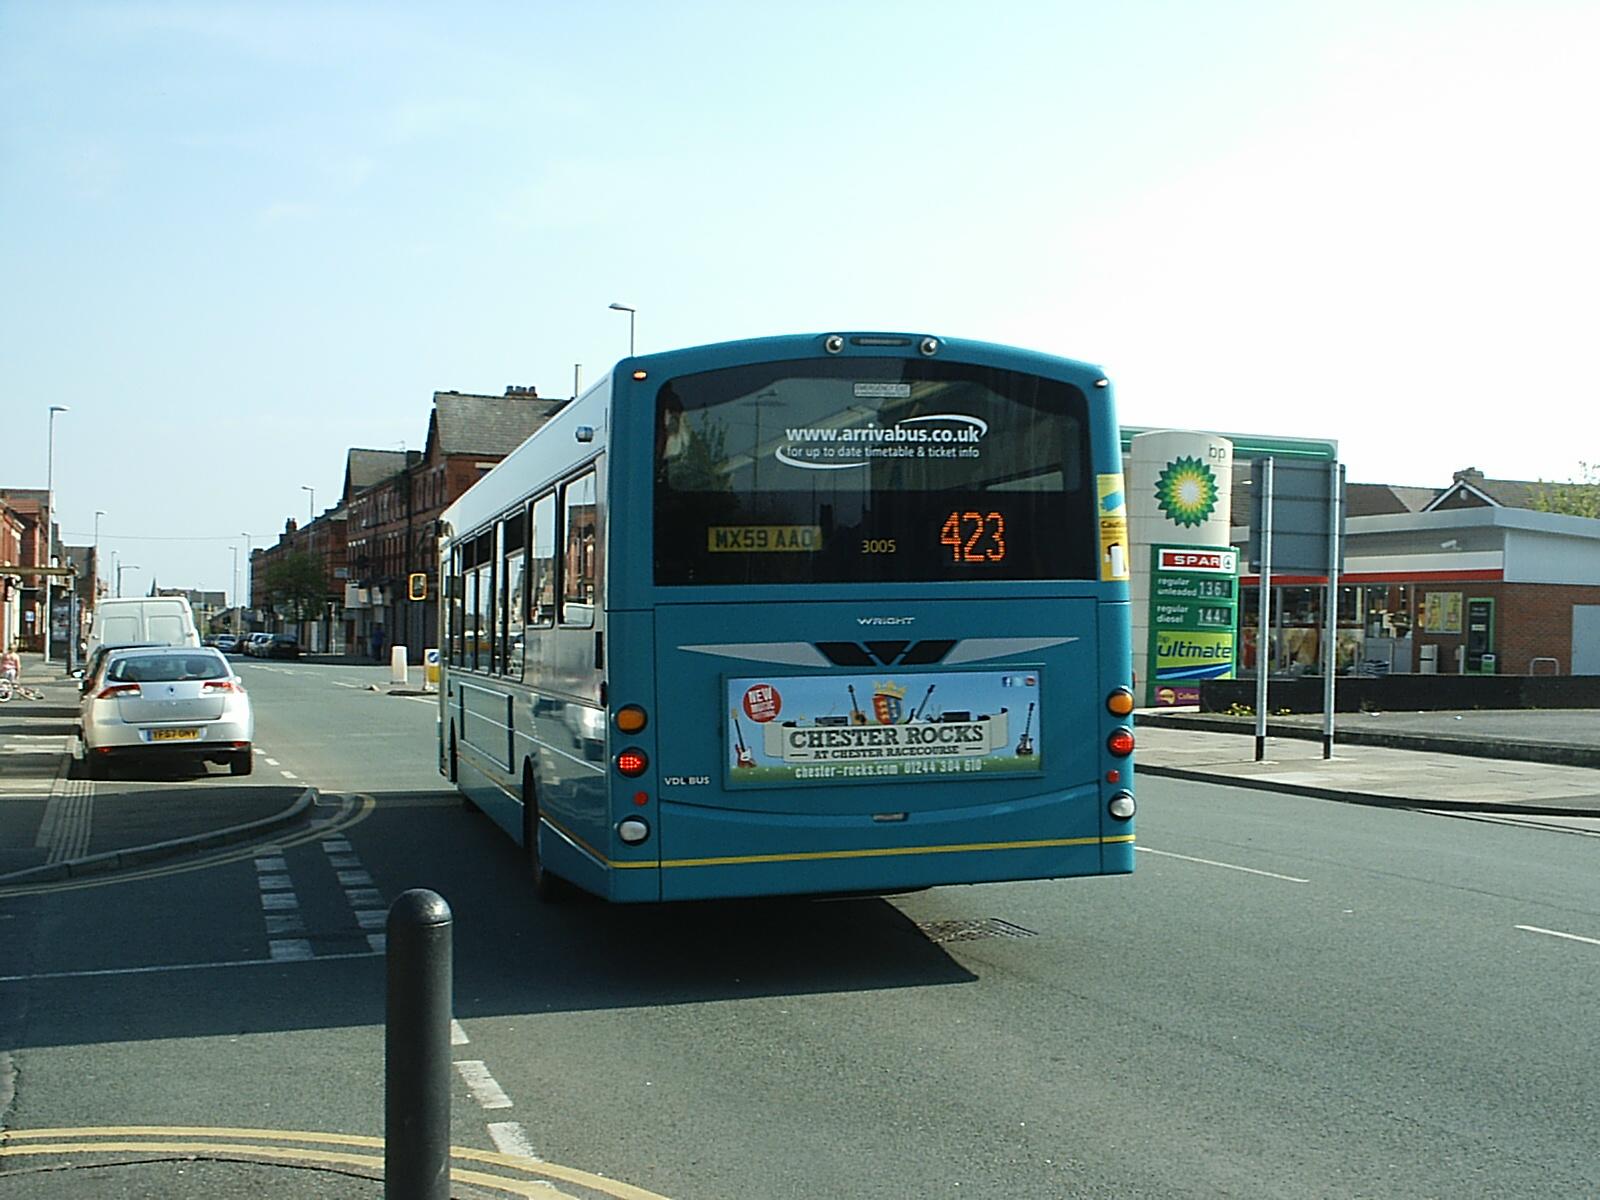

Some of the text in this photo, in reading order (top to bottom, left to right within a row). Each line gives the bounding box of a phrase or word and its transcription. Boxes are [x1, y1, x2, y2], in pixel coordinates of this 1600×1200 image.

[786, 423, 980, 443] www.arrivabus.co.uk
[787, 446, 980, 459] for up to date timetable & ticket info
[1209, 444, 1226, 462] bp
[716, 529, 768, 548] MX59
[940, 512, 1006, 562] 423
[862, 540, 896, 553] 3005
[1174, 555, 1221, 567] SPAR
[1158, 578, 1190, 587] regular
[1157, 588, 1197, 597] unleaded
[1157, 605, 1189, 614] regular
[857, 617, 916, 625] WRIGHT
[1156, 615, 1184, 623] diesel
[1158, 640, 1232, 658] ultimate
[789, 725, 984, 748] CHESTER ROCKS
[814, 745, 960, 760] AT CHESTER RACECOURSE
[795, 763, 898, 779] chester-rocks.com
[664, 776, 710, 785] VDL BUS
